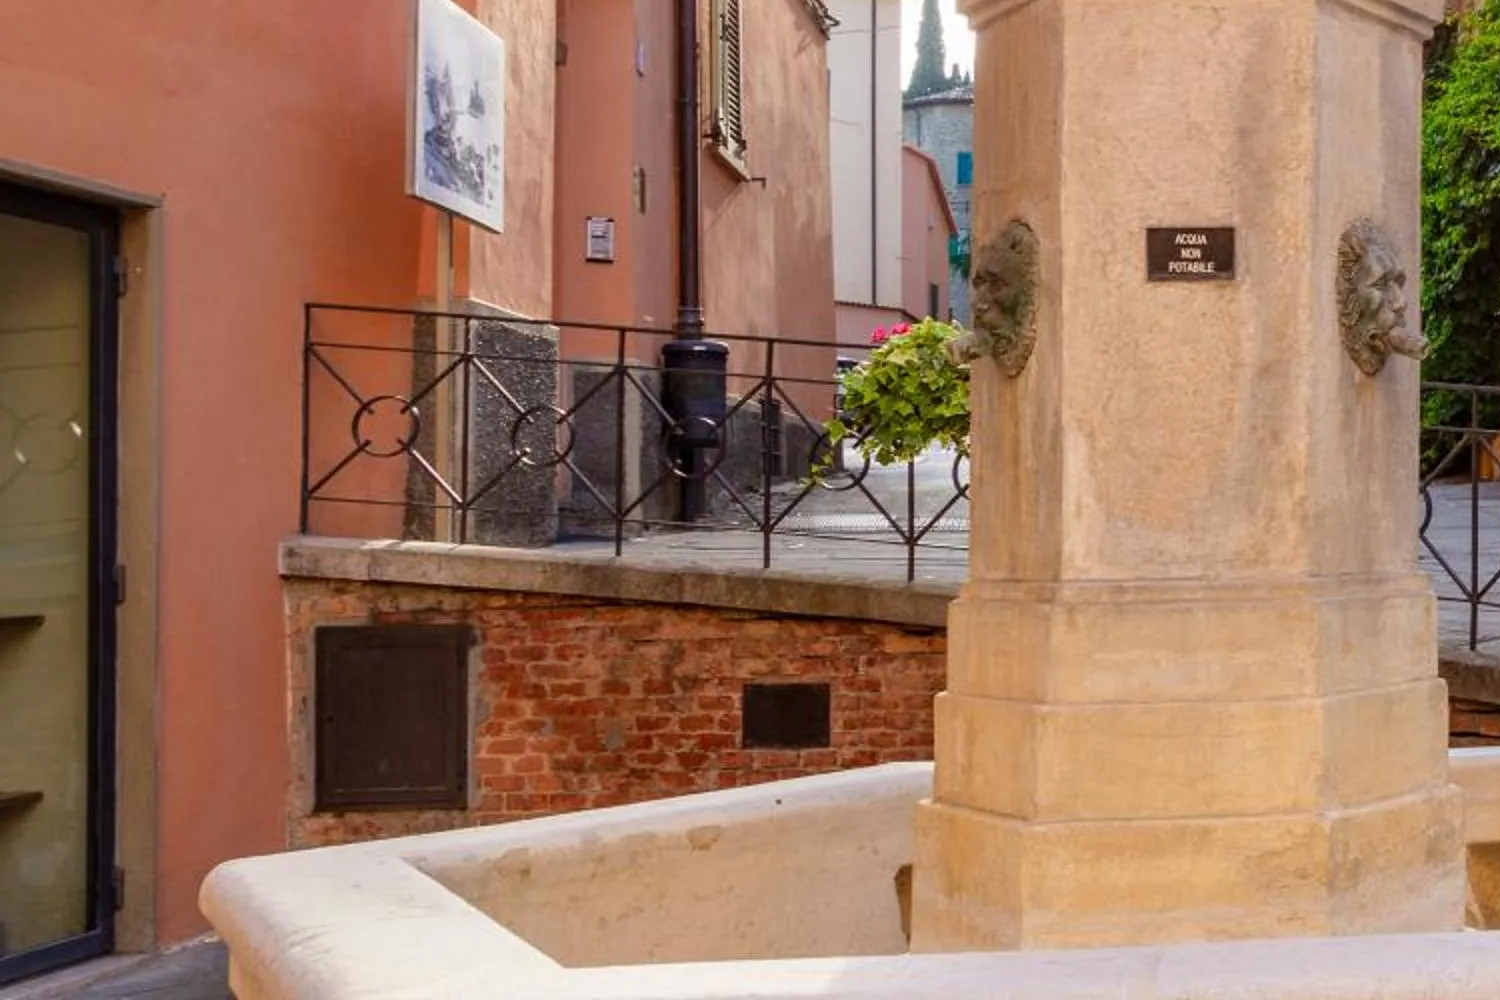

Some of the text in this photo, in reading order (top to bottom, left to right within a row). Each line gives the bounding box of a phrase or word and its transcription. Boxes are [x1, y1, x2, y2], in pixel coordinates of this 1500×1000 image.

[1175, 233, 1207, 245] ACQUA
[1181, 247, 1201, 259] NON
[1168, 261, 1215, 273] POTABILE
